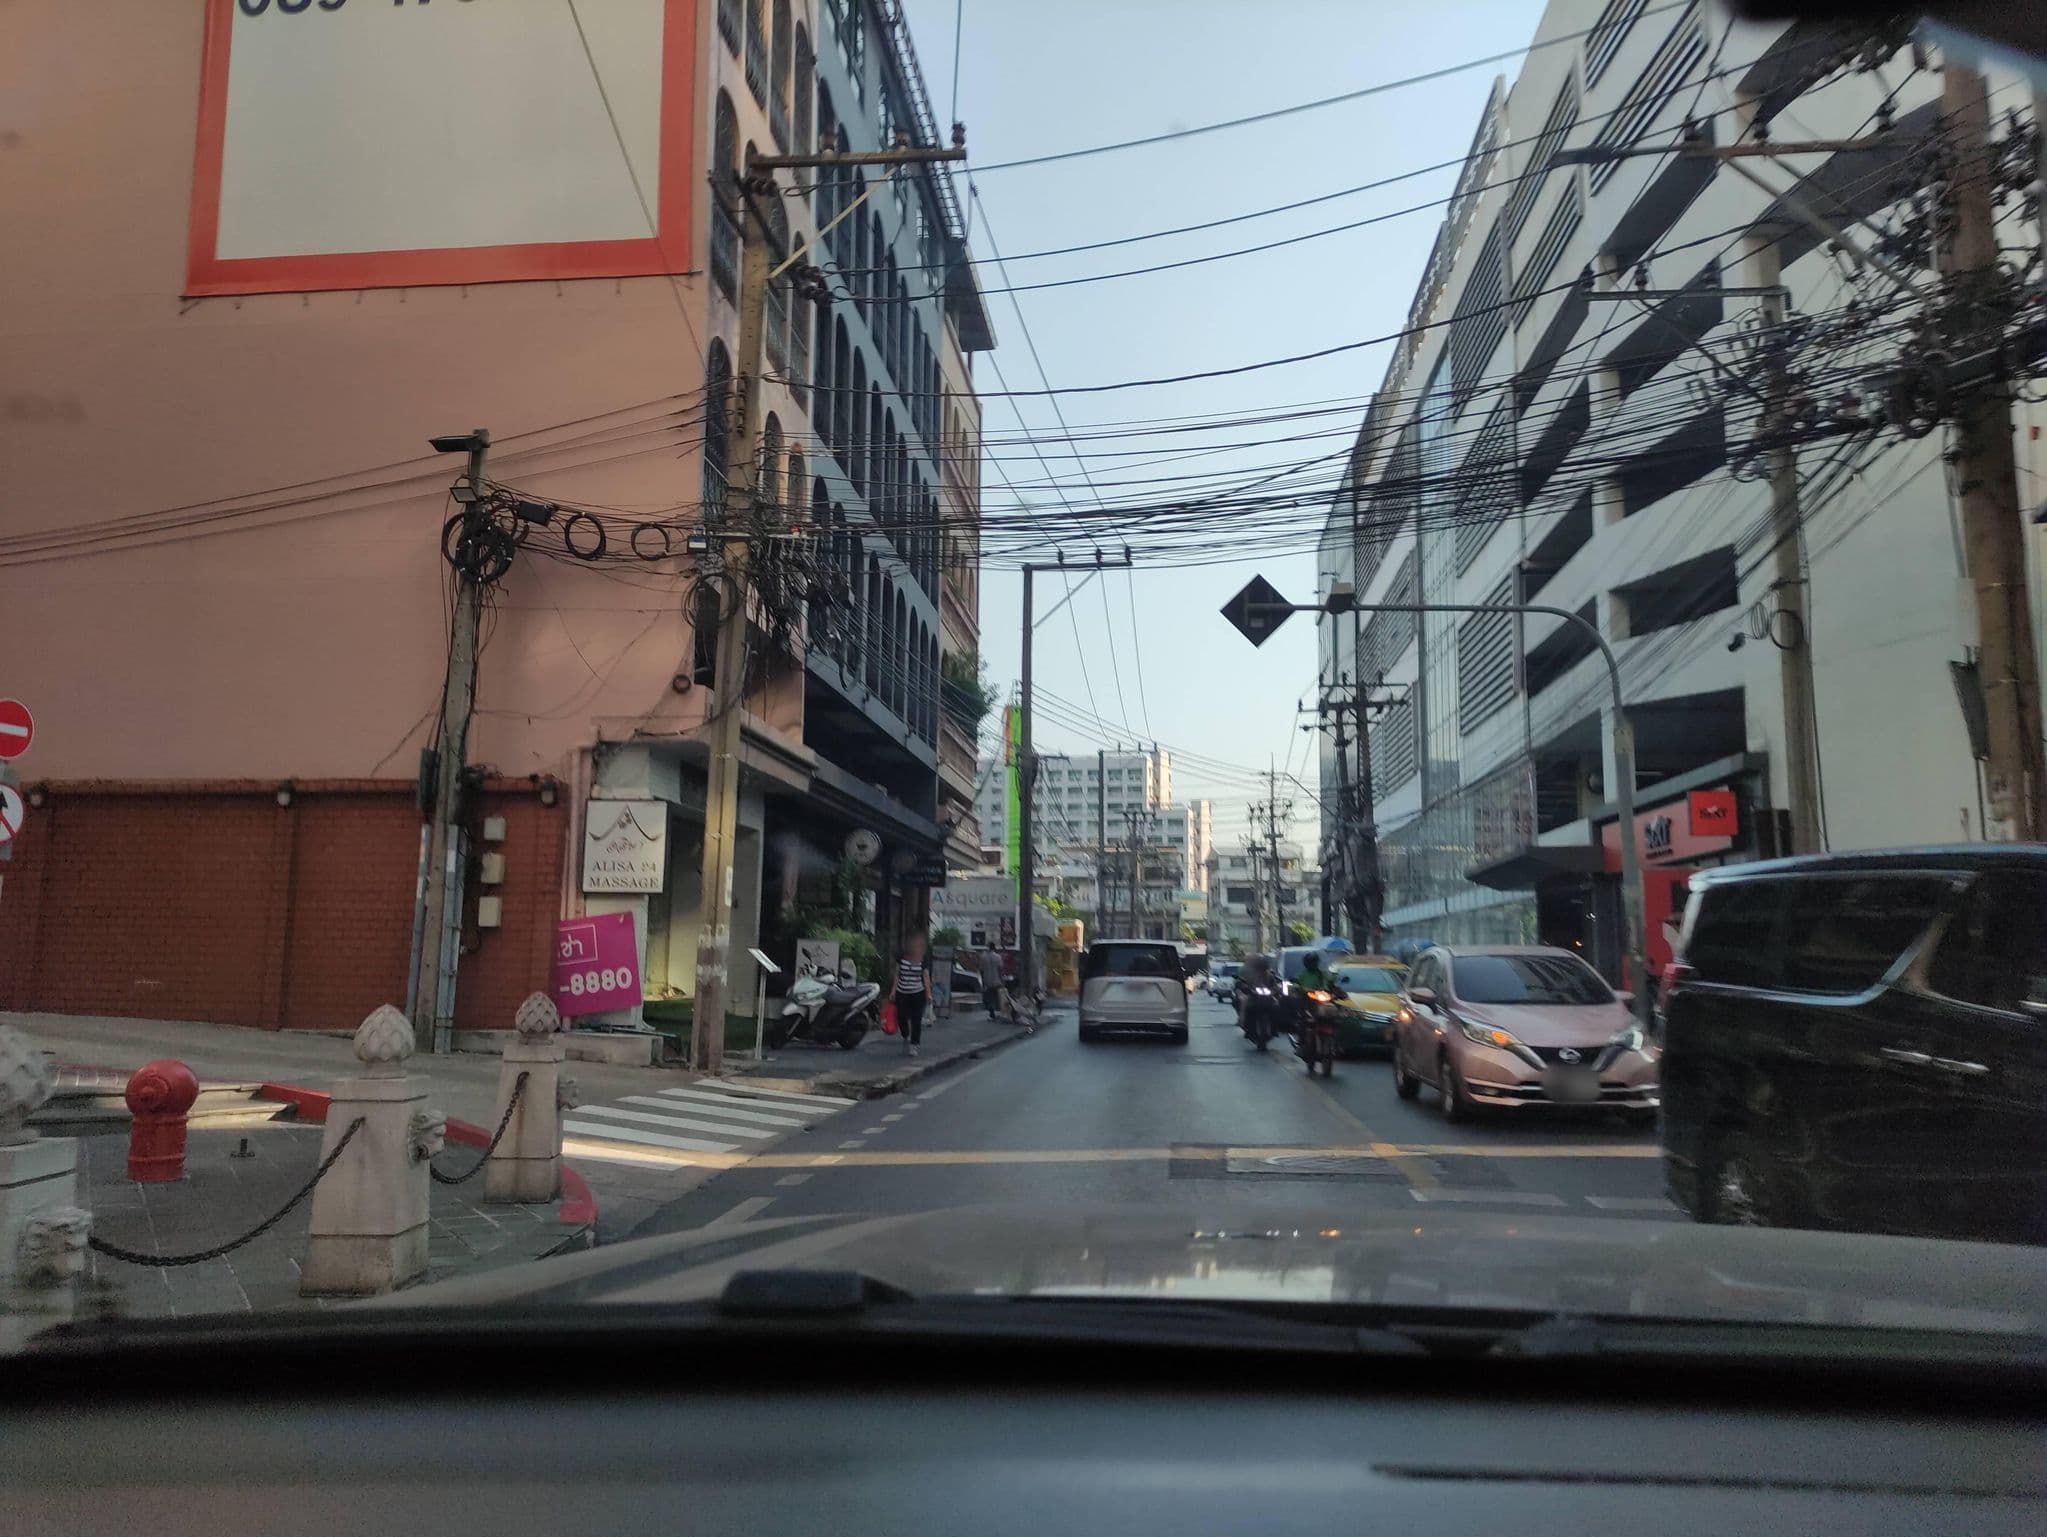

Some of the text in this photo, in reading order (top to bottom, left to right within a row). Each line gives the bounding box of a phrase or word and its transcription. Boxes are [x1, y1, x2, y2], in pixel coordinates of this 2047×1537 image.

[592, 860, 635, 873] ALISA
[590, 876, 659, 889] MASSAGE
[559, 933, 584, 958] ช่า
